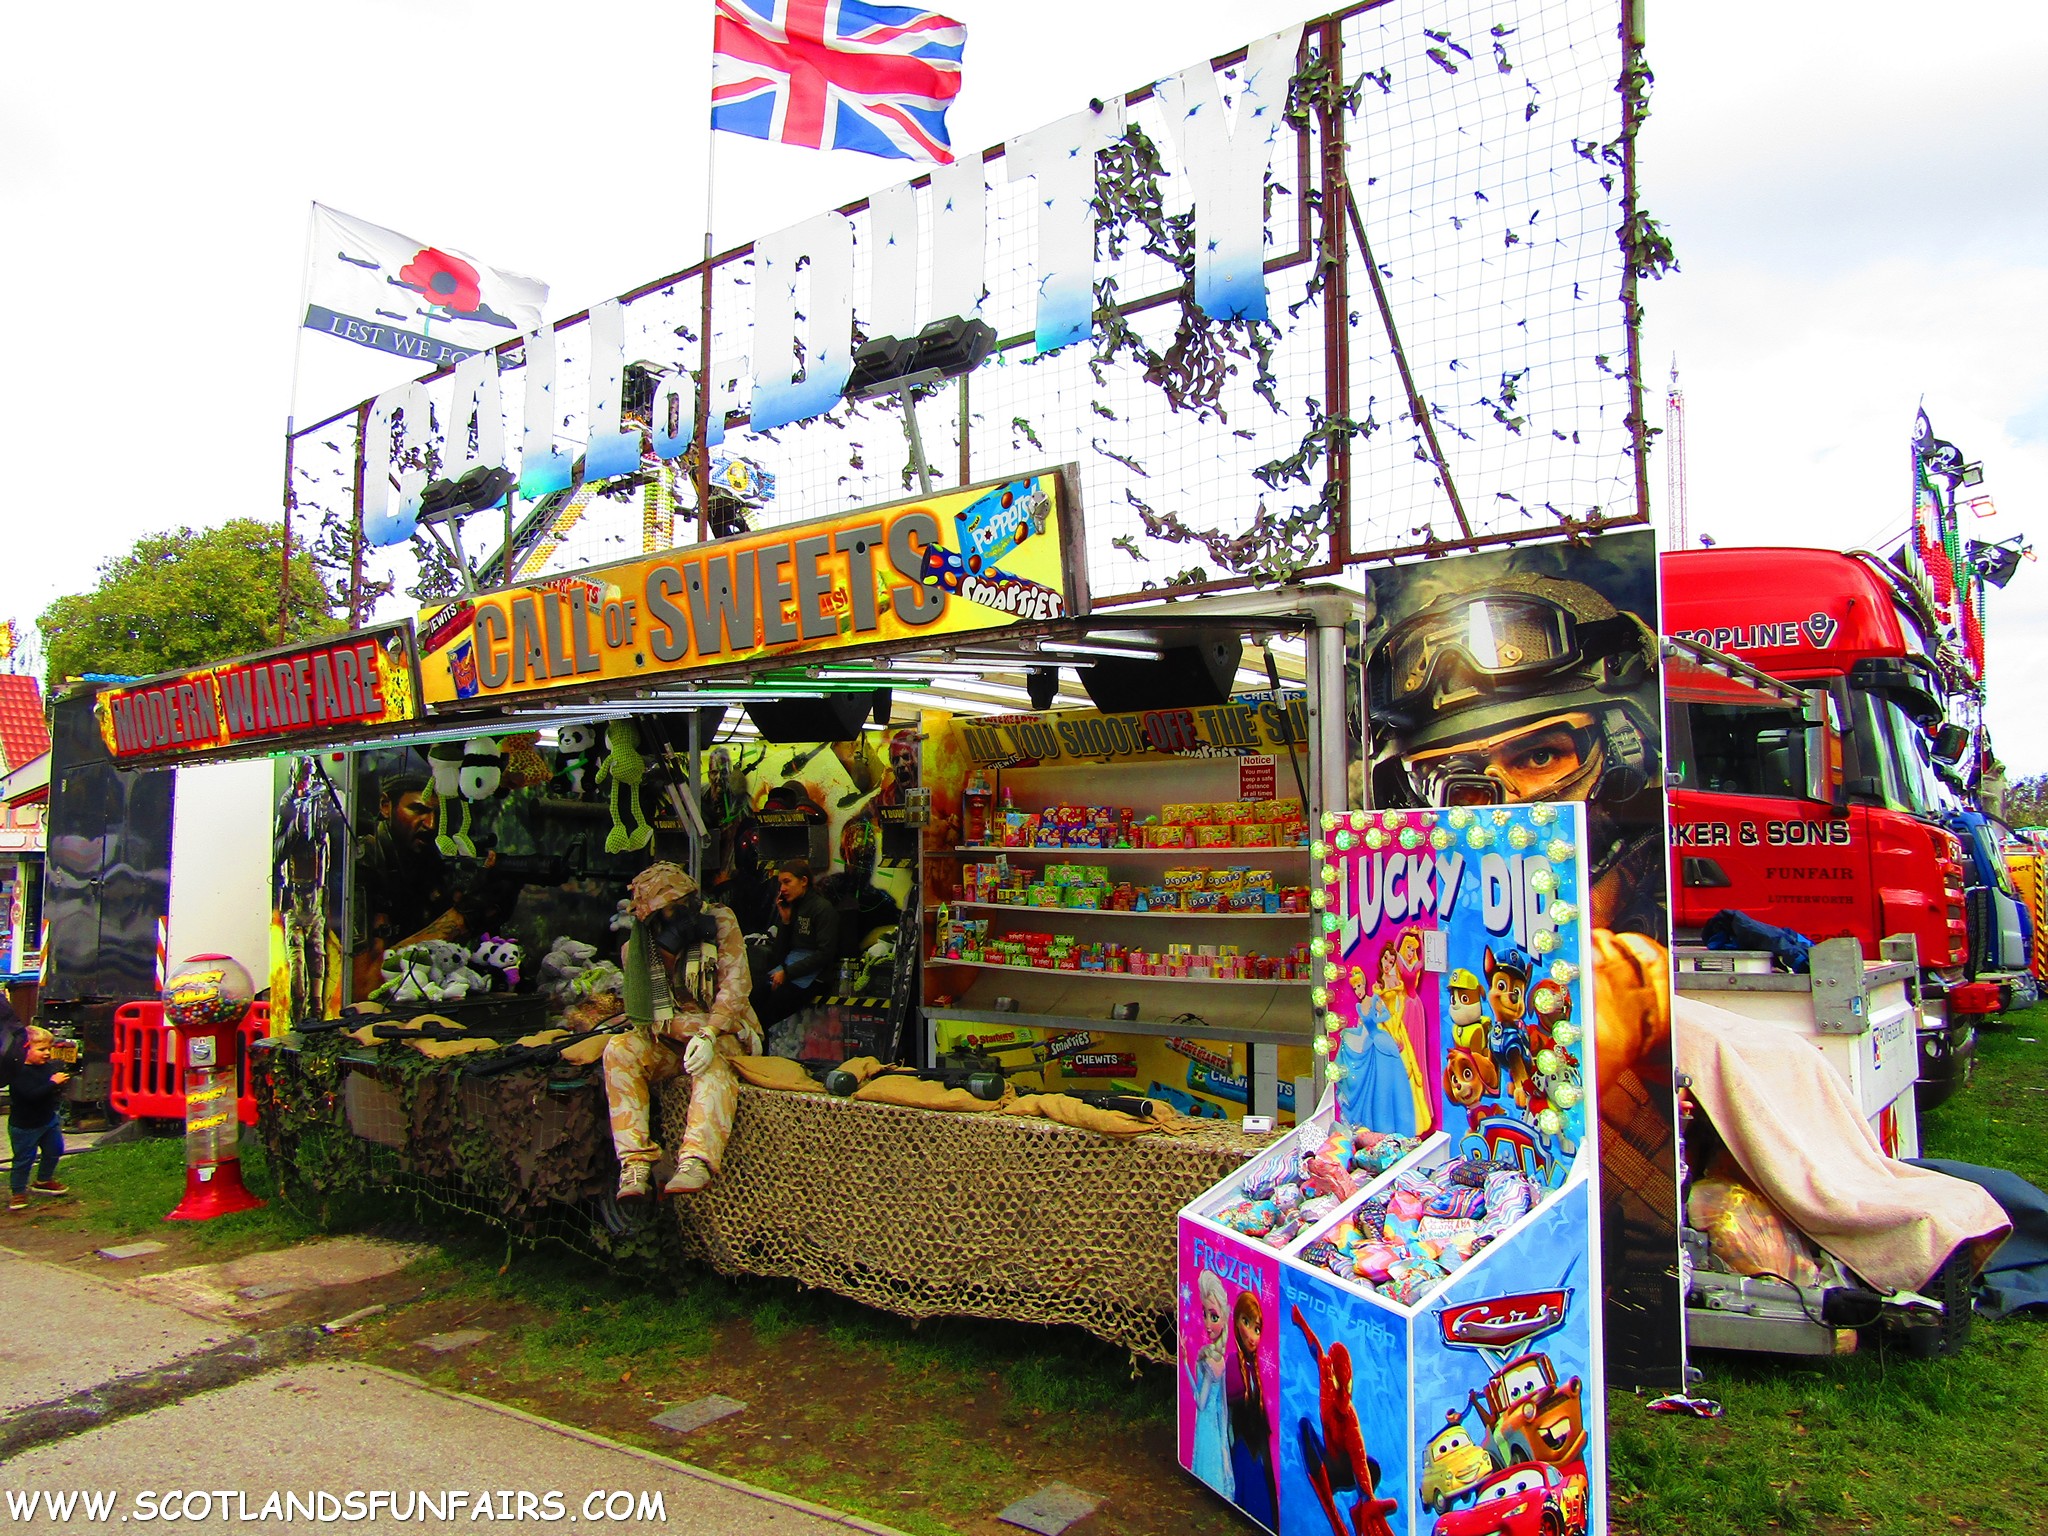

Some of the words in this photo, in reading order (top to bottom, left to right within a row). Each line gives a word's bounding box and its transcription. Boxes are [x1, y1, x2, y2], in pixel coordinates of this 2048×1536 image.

[362, 298, 641, 547] CALL
[652, 355, 751, 459] OF
[750, 21, 1305, 433] DUTY
[327, 316, 385, 344] LEST
[392, 331, 431, 358] WE
[475, 587, 600, 689] CALL
[604, 600, 637, 648] OF
[646, 512, 946, 663] SWEETS
[110, 679, 220, 752] MODERN
[218, 645, 382, 735] WARFARE
[963, 727, 1009, 763] ALL
[1003, 722, 1061, 760] YOU
[1057, 715, 1145, 758] SHOOT
[1144, 709, 1197, 751] OFF
[1197, 703, 1262, 748] THE
[1243, 756, 1271, 765] Notice
[1242, 776, 1256, 784] keep
[1738, 821, 1760, 846] &
[1766, 820, 1851, 846] SONS
[1174, 871, 1203, 886] DOTS
[1214, 871, 1241, 886] DOTS
[1765, 867, 1854, 880] FUNFAIR
[1192, 892, 1220, 906] DOTS
[1233, 892, 1262, 907] DOTS
[1767, 894, 1854, 905] LUTTERWORTH
[1339, 851, 1466, 963] LUCKY
[1480, 852, 1559, 968] DIP
[979, 1031, 1015, 1044] Starburst
[1193, 1238, 1264, 1298] FROZEN
[1452, 1304, 1562, 1339] Cars
